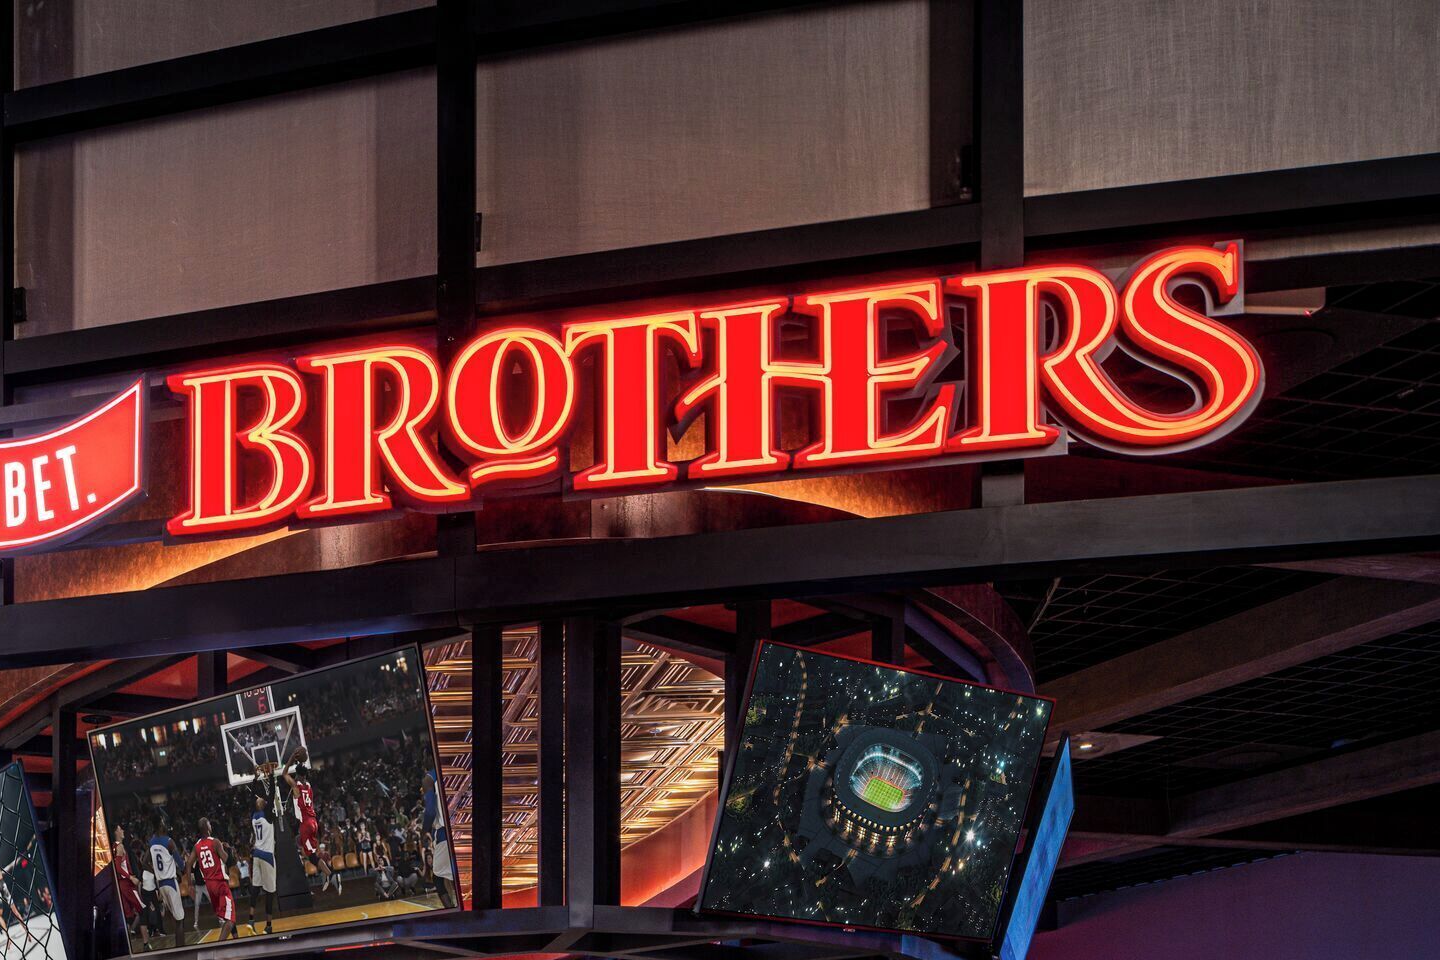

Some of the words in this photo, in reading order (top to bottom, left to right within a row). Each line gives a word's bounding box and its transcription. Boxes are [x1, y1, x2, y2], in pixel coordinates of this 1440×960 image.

[3, 445, 97, 528] BET.
[165, 240, 1261, 537] BROTHERS
[156, 853, 164, 872] 6
[200, 850, 215, 869] 23
